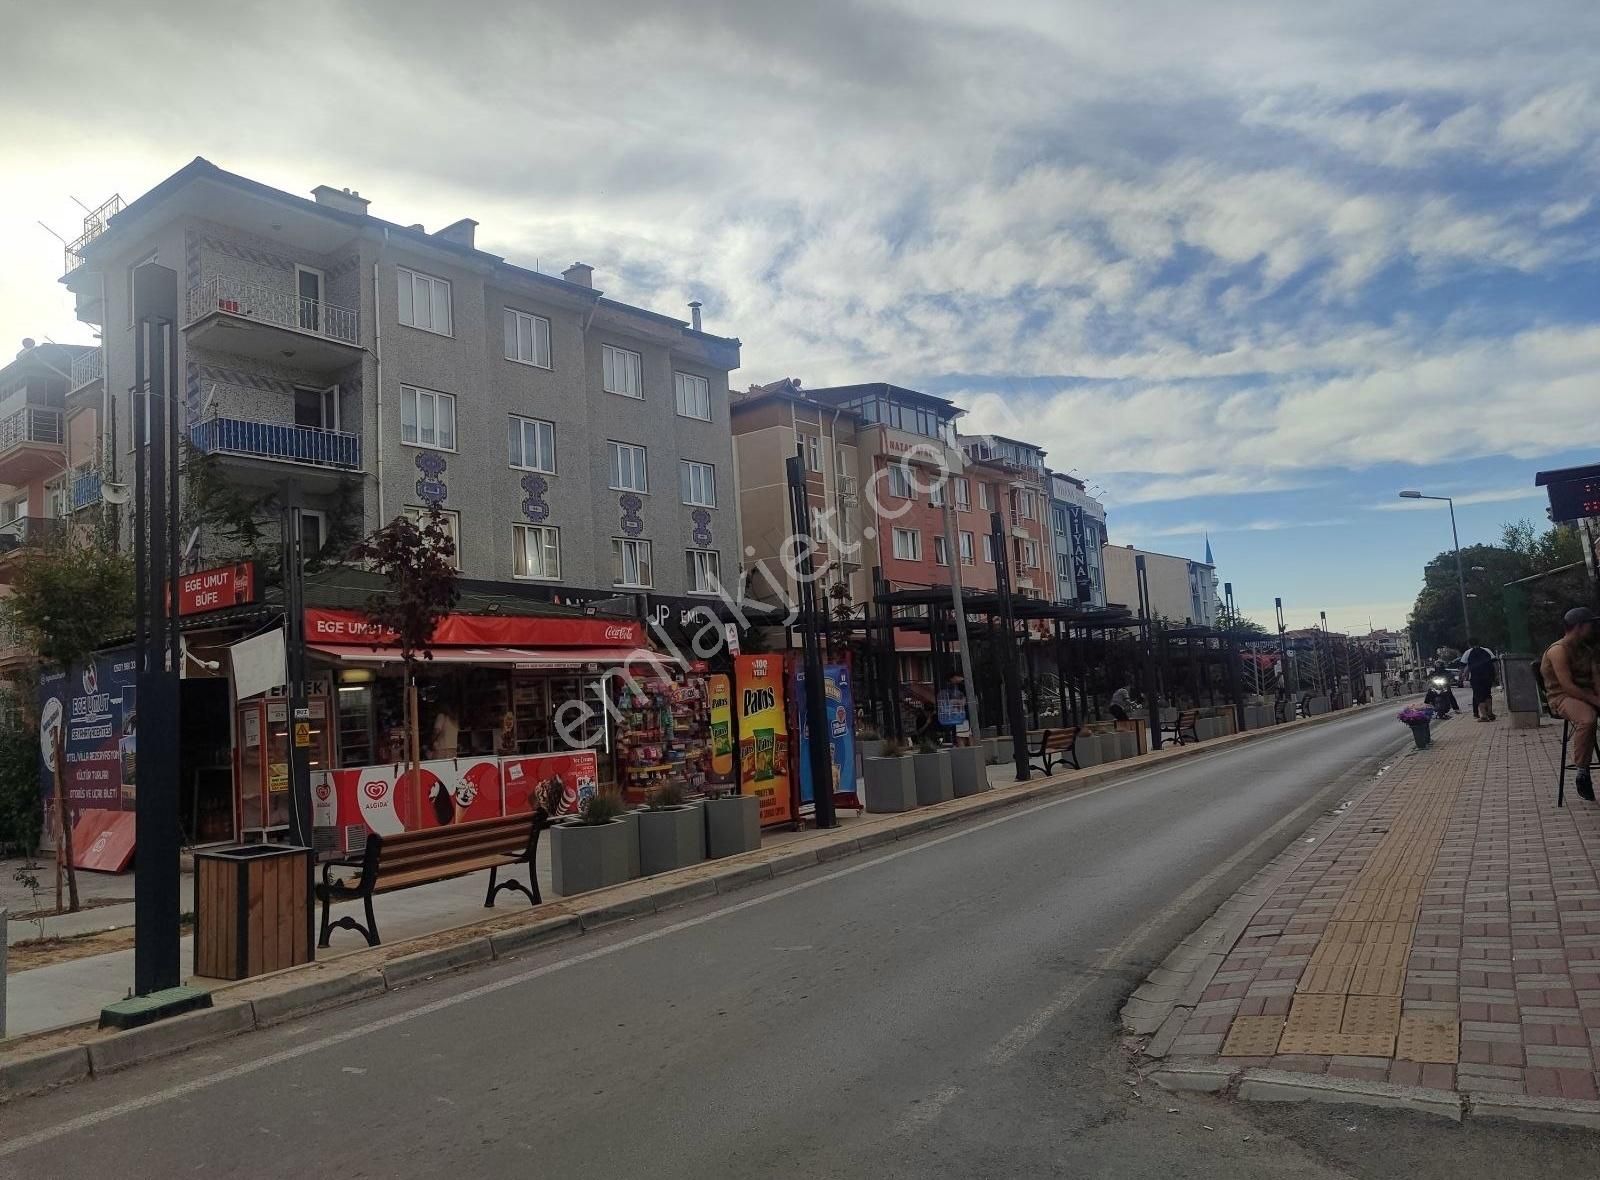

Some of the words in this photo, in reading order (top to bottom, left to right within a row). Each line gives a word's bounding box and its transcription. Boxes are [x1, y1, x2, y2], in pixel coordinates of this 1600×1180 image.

[185, 578, 202, 593] EGE
[203, 572, 228, 588] UMUT
[195, 591, 218, 607] BÜFE
[317, 620, 344, 633] EGE
[87, 693, 110, 715] UMUT
[743, 686, 775, 718] Patos
